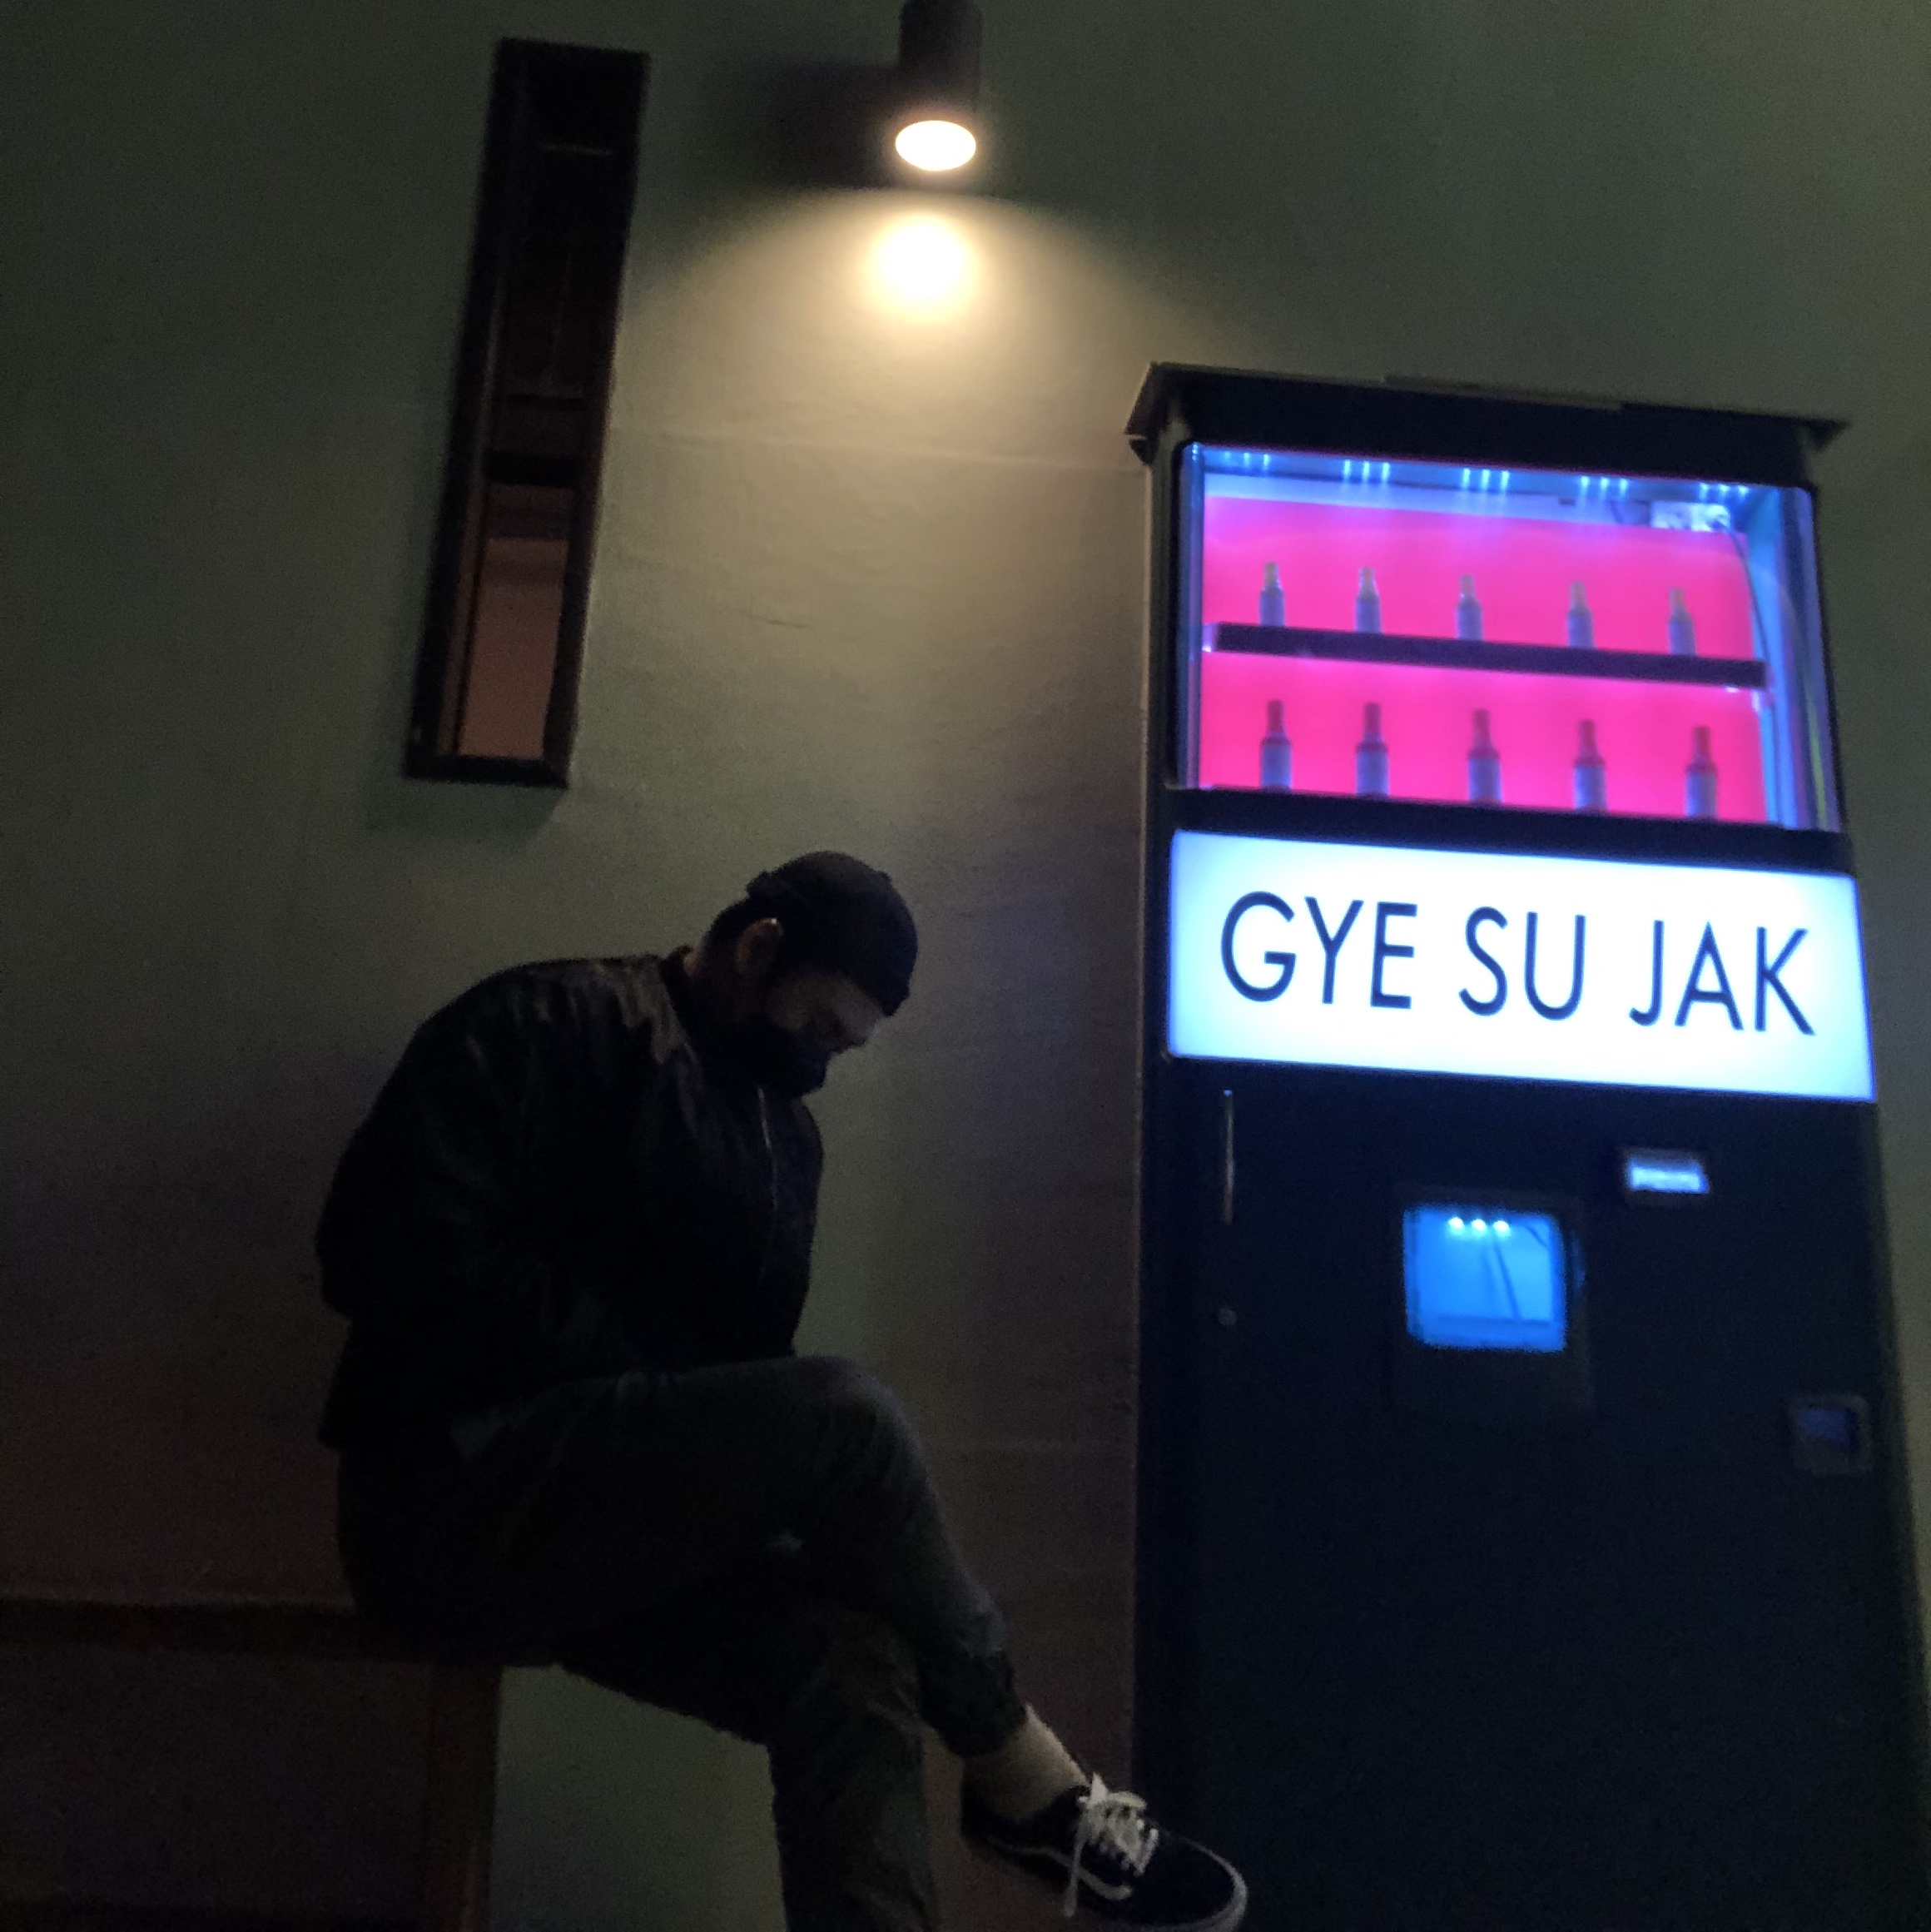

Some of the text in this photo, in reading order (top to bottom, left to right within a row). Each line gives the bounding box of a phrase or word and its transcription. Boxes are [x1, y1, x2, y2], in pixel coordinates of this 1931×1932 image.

[1220, 890, 1815, 1036] GYE SU JAK
